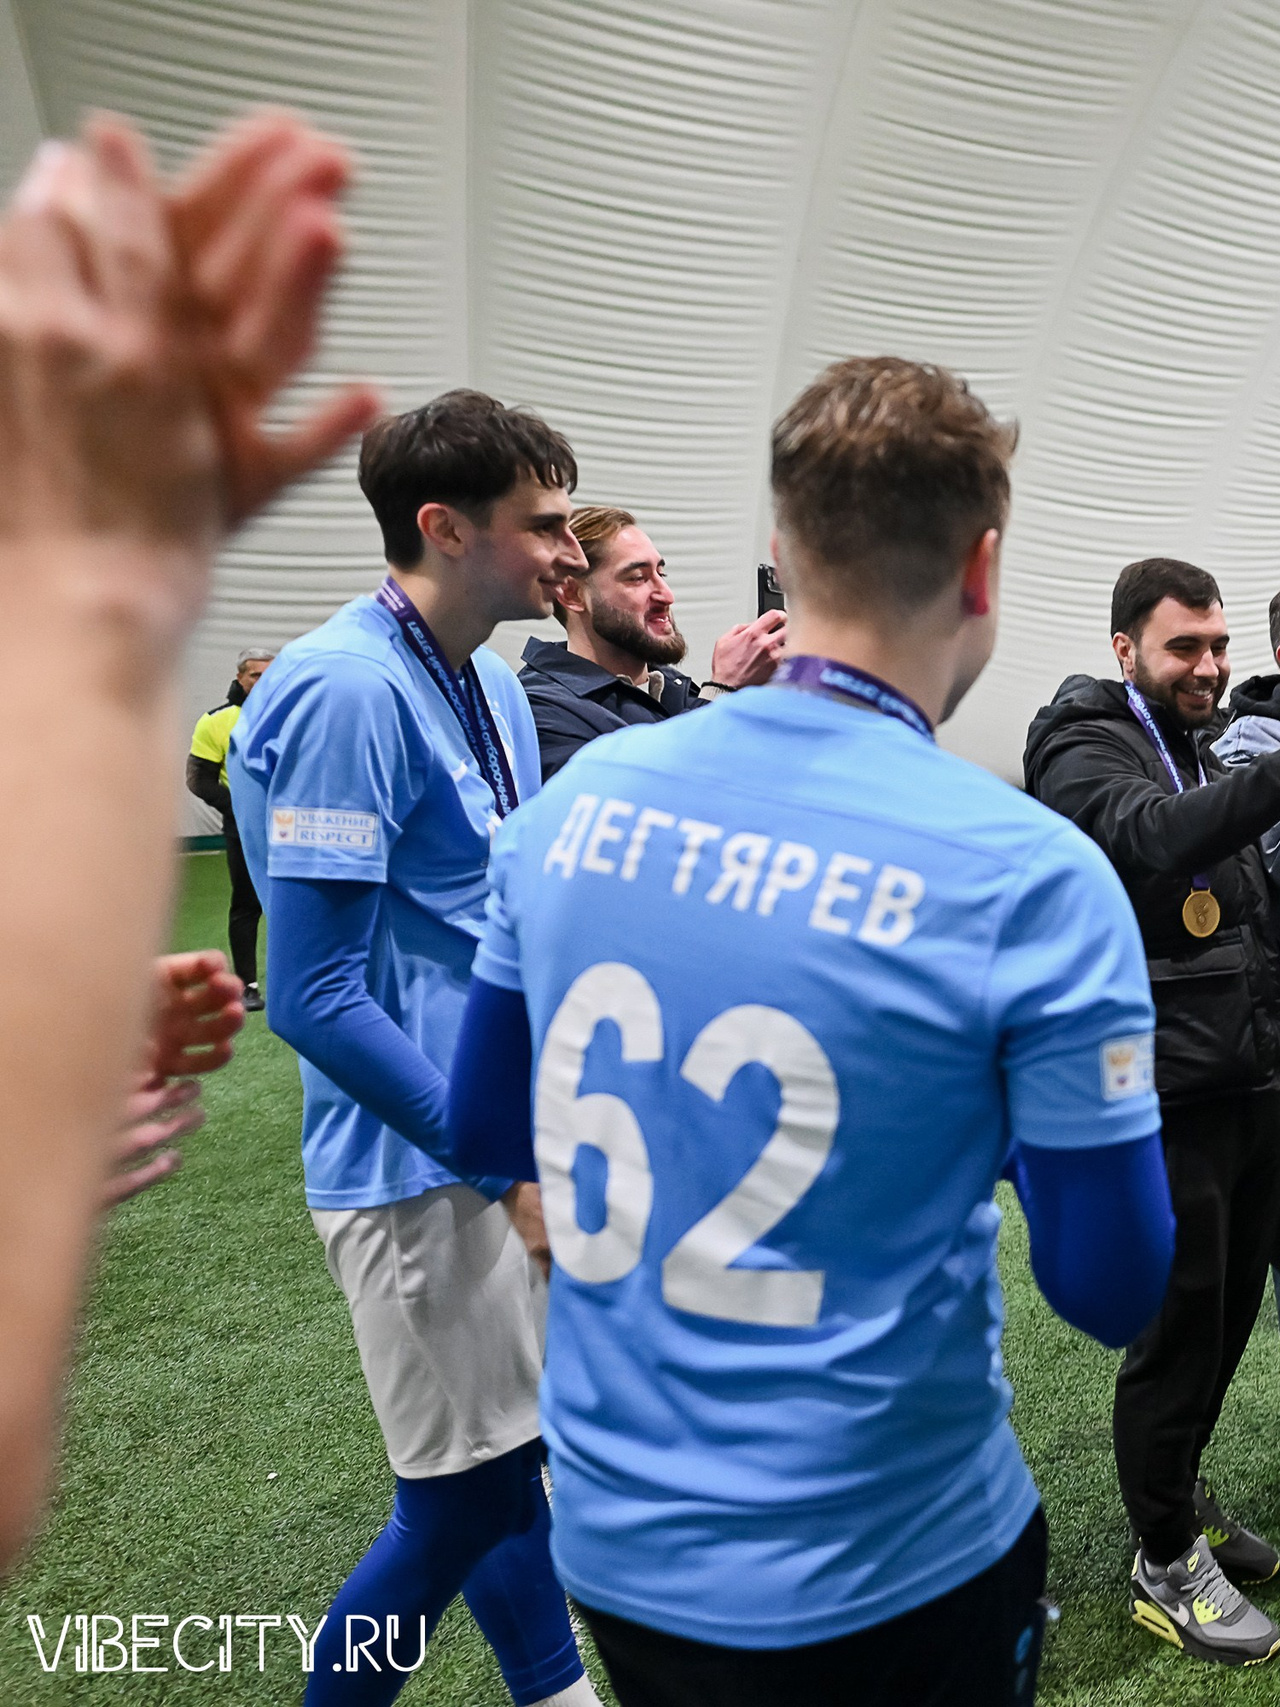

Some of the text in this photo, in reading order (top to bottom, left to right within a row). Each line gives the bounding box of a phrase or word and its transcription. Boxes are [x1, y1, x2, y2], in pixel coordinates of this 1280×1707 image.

[300, 831, 370, 845] RESPECT
[543, 793, 926, 948] ДЕГТЯРЕВ
[533, 961, 841, 1327] 62
